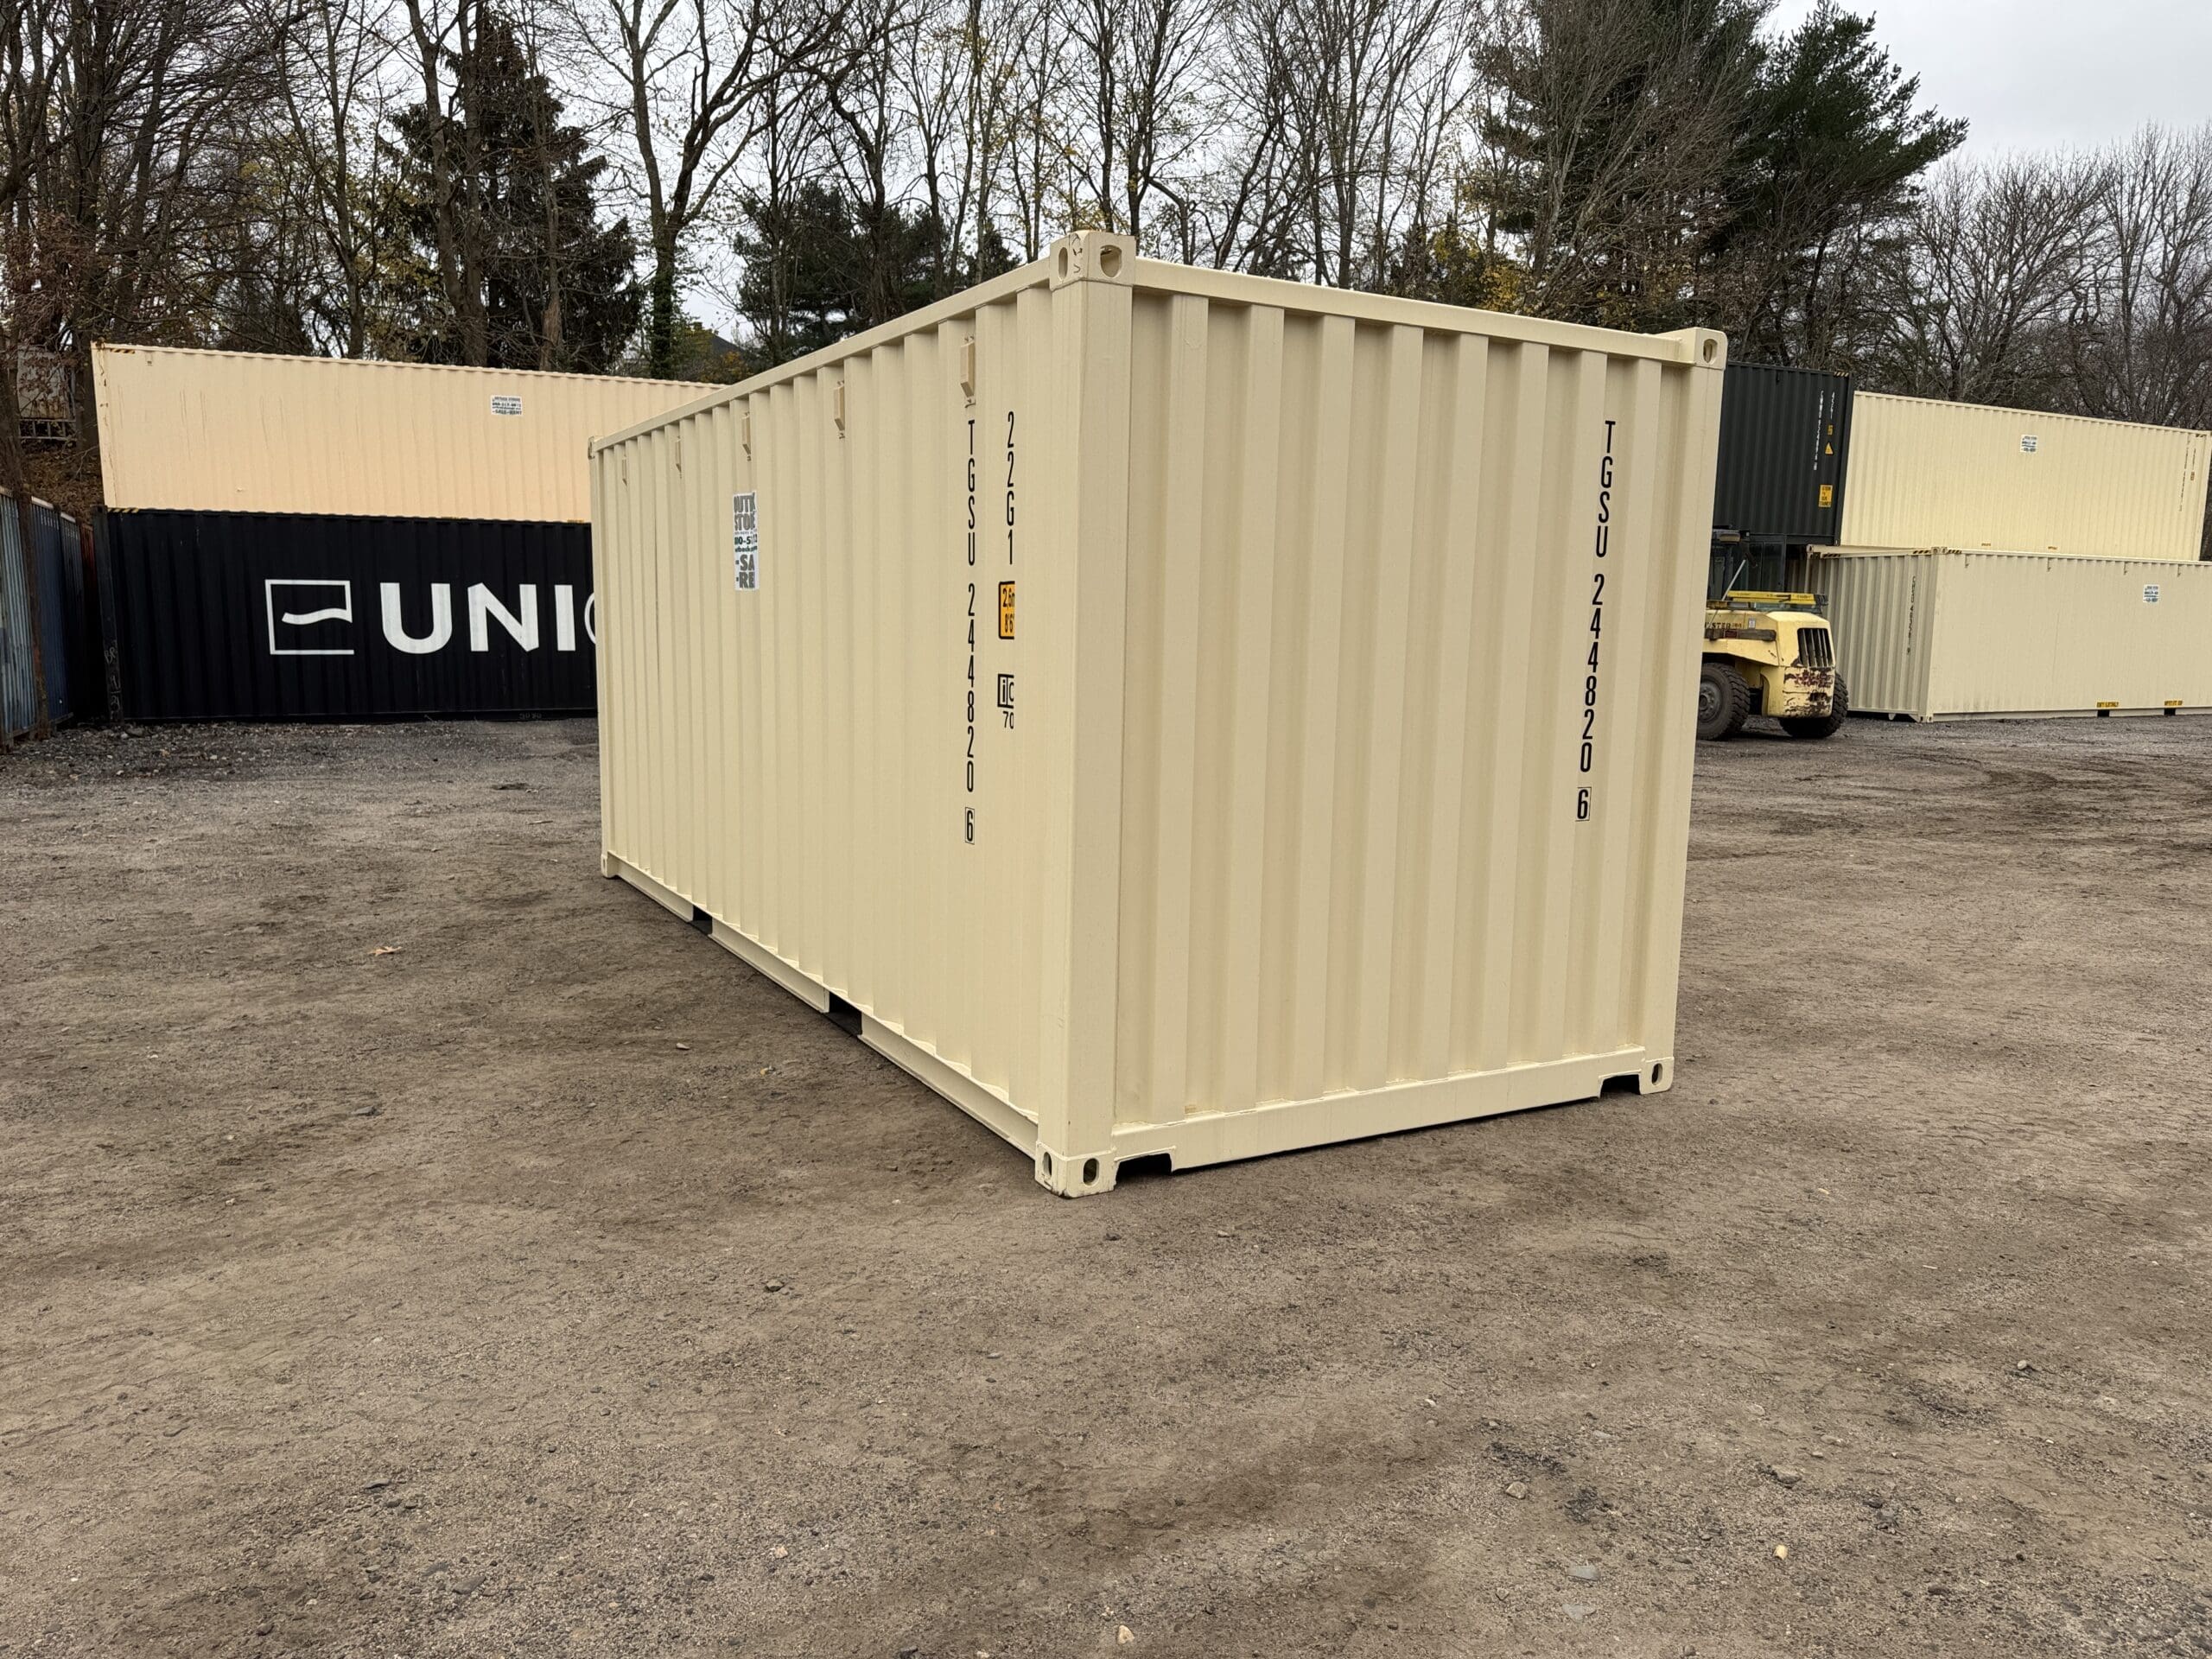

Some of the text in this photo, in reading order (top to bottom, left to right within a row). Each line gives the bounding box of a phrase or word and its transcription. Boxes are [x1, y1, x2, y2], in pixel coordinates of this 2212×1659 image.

[1006, 410, 1014, 565] 22G1
[379, 582, 596, 654] UNI
[966, 582, 976, 793] 244820
[1577, 420, 1617, 820] TGSU 244820 6
[964, 810, 974, 842] 6
